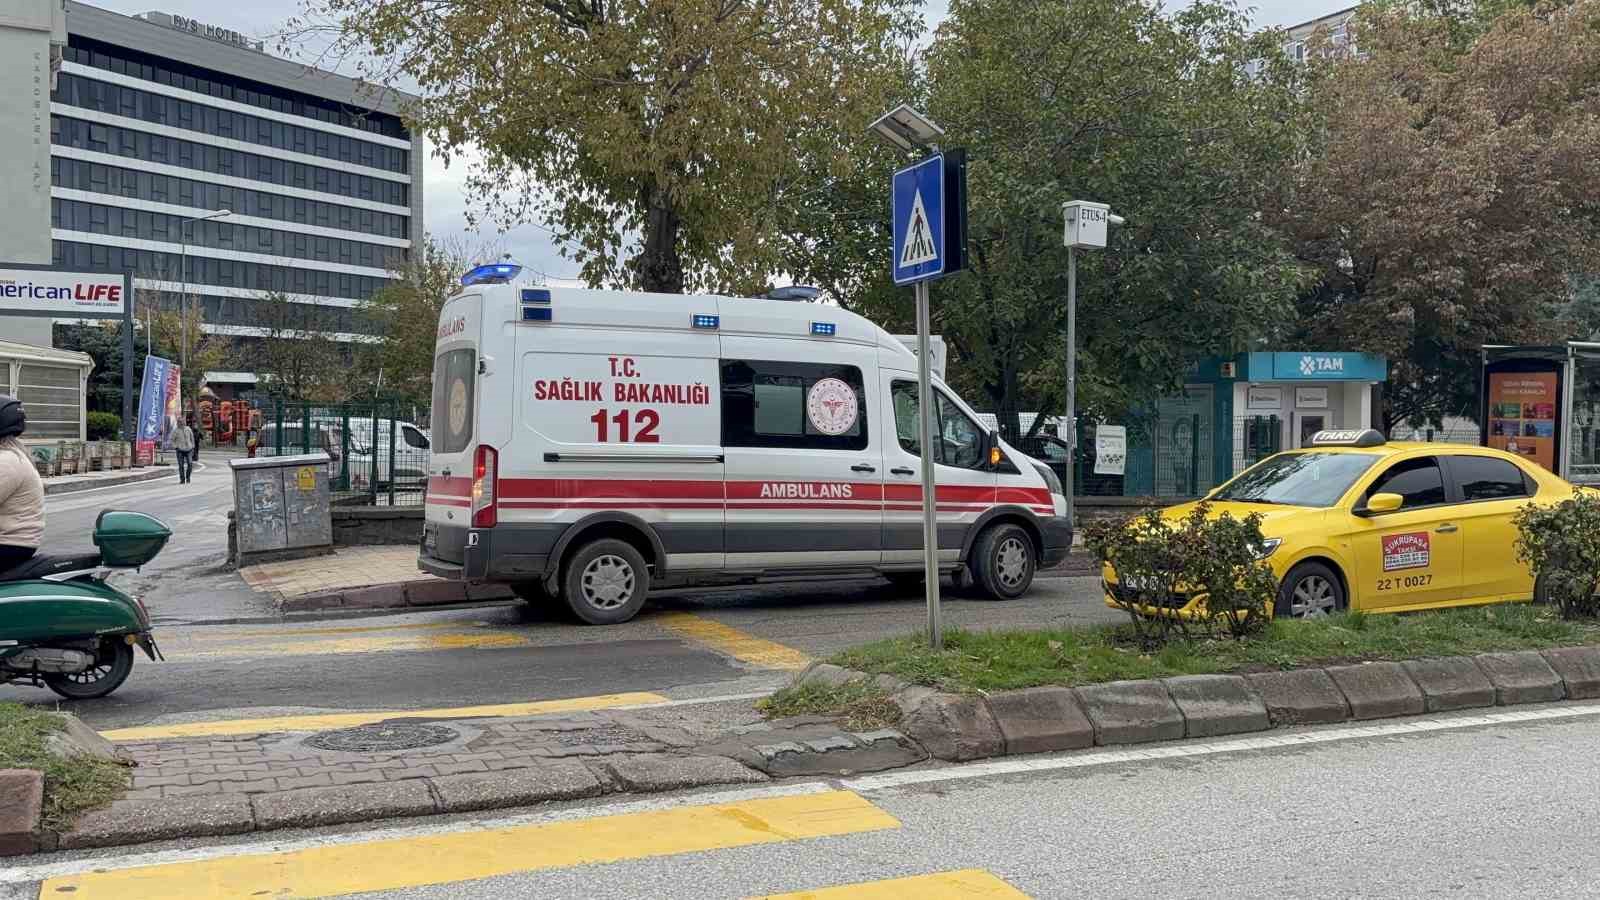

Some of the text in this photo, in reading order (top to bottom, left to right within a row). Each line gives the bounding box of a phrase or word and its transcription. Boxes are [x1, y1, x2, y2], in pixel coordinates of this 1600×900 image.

[0, 282, 122, 302] erican LIFE
[608, 357, 641, 377] T.C.
[1317, 357, 1343, 370] TAM
[534, 377, 710, 405] SAĞLIK BAKANLIĞI
[590, 408, 660, 443] 112
[760, 483, 853, 498] AMBULANS
[1377, 575, 1433, 590] 22 T 0027
